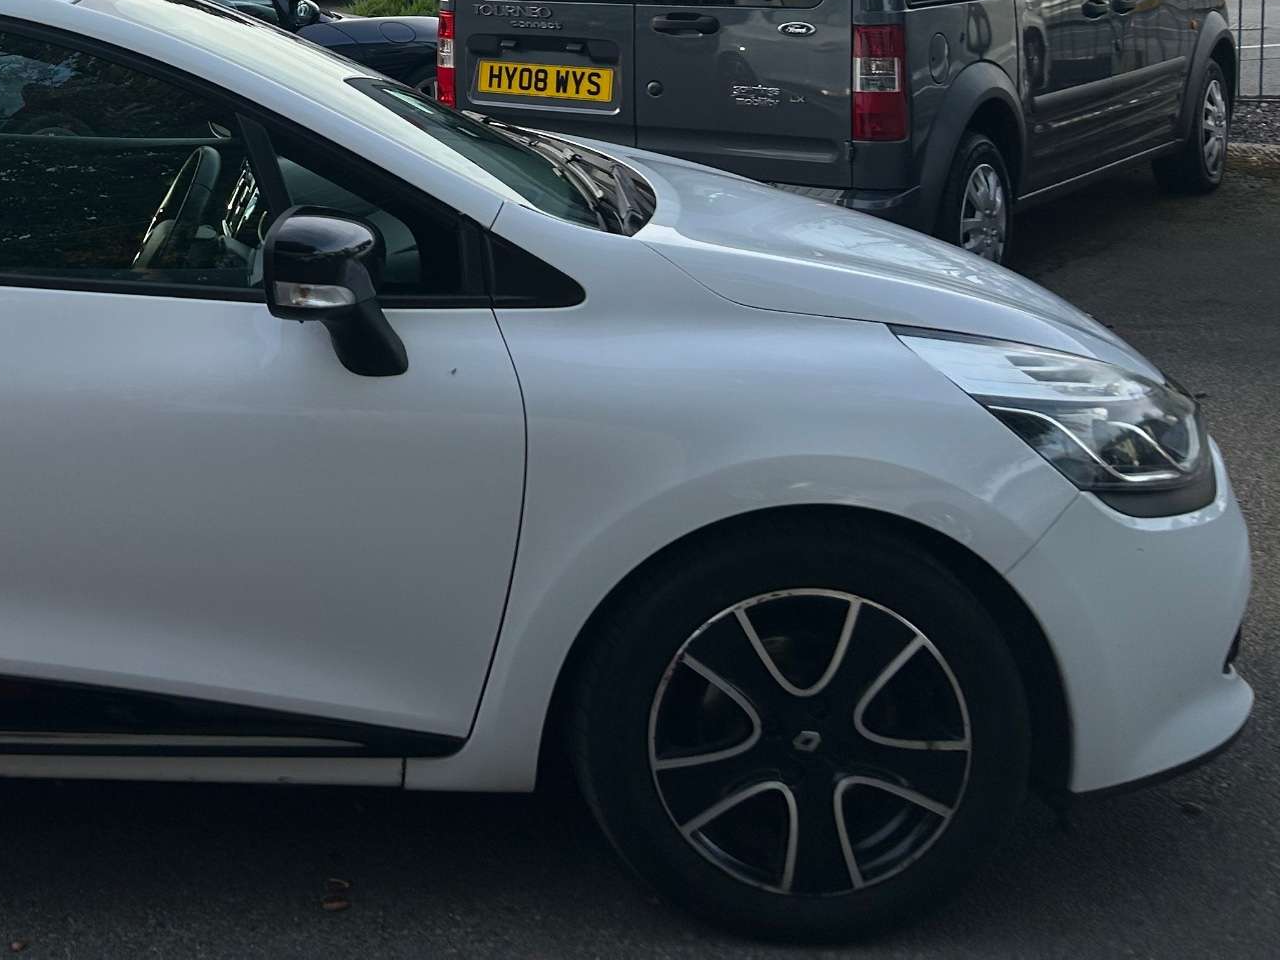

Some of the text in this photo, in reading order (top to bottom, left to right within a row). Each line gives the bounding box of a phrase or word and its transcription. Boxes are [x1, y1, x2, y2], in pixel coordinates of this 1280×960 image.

[472, 4, 552, 18] TOURNEO
[511, 20, 562, 30] connect
[488, 65, 601, 96] HY08 WYS
